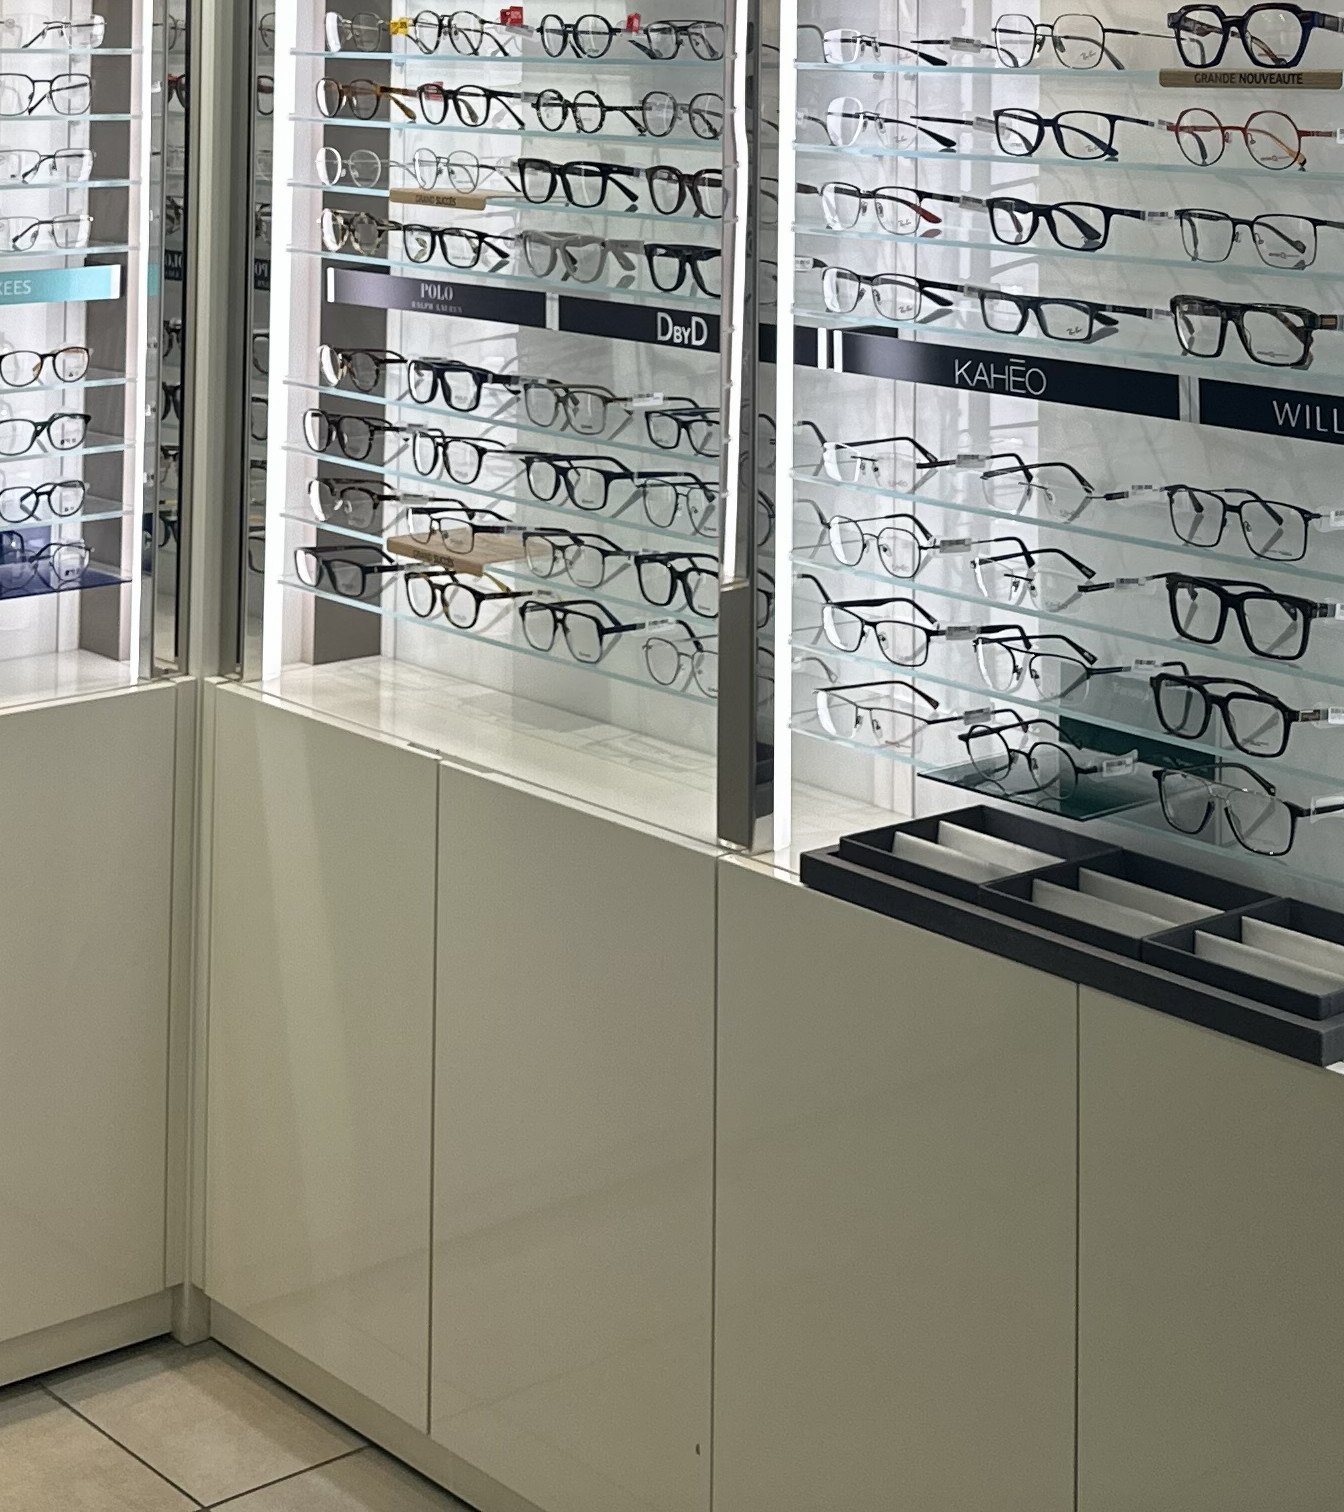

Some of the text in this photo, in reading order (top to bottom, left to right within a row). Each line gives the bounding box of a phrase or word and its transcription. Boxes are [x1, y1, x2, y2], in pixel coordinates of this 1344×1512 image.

[1194, 71, 1304, 85] GRANDE NOUVEAUTE
[419, 282, 454, 302] POLO
